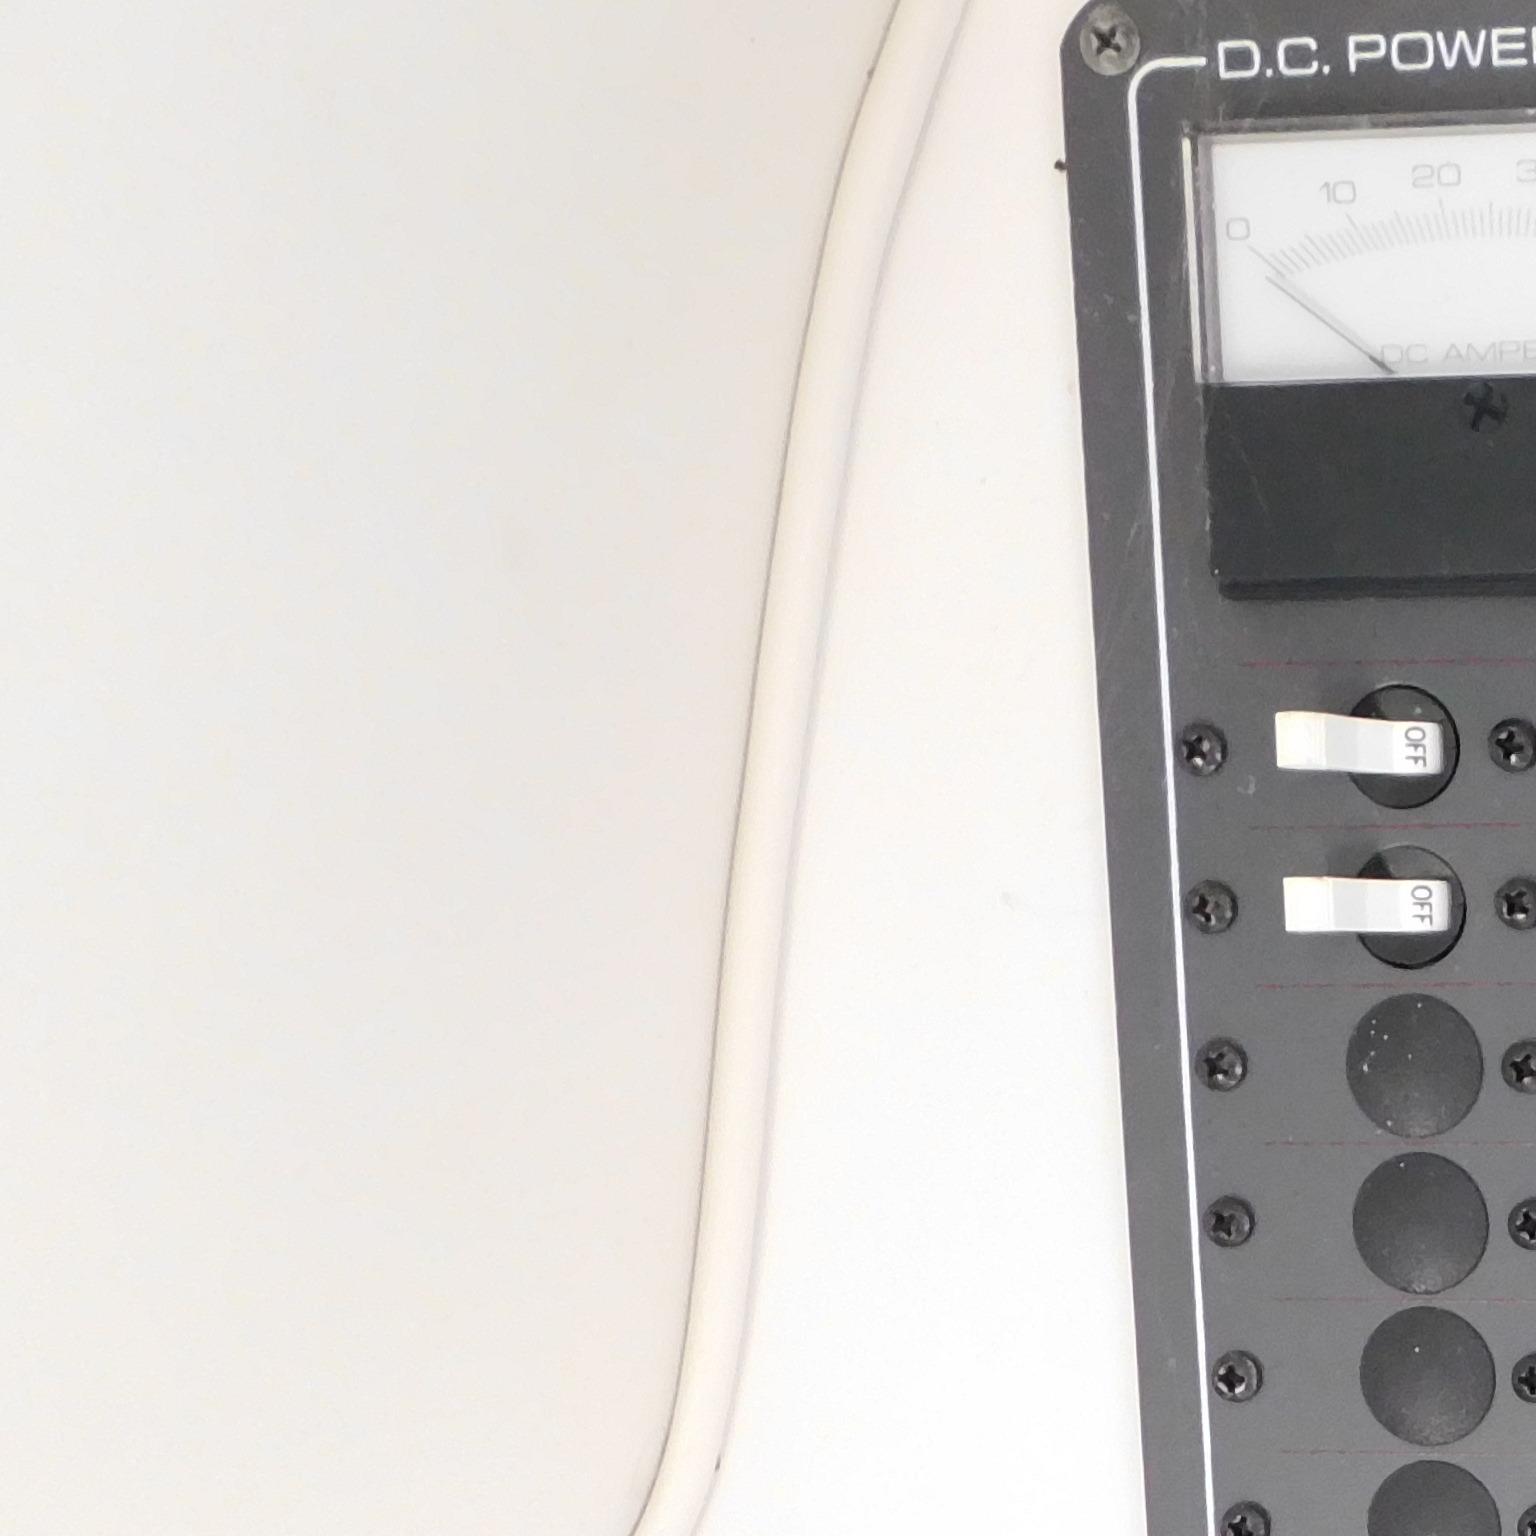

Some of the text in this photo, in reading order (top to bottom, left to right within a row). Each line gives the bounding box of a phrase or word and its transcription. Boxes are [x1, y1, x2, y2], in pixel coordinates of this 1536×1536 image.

[1217, 36, 1330, 80] D.C.
[1319, 180, 1357, 205] 10
[1411, 161, 1462, 189] 20
[1380, 342, 1431, 365] DC
[1404, 726, 1428, 768] OFF
[1410, 884, 1434, 927] OFF
